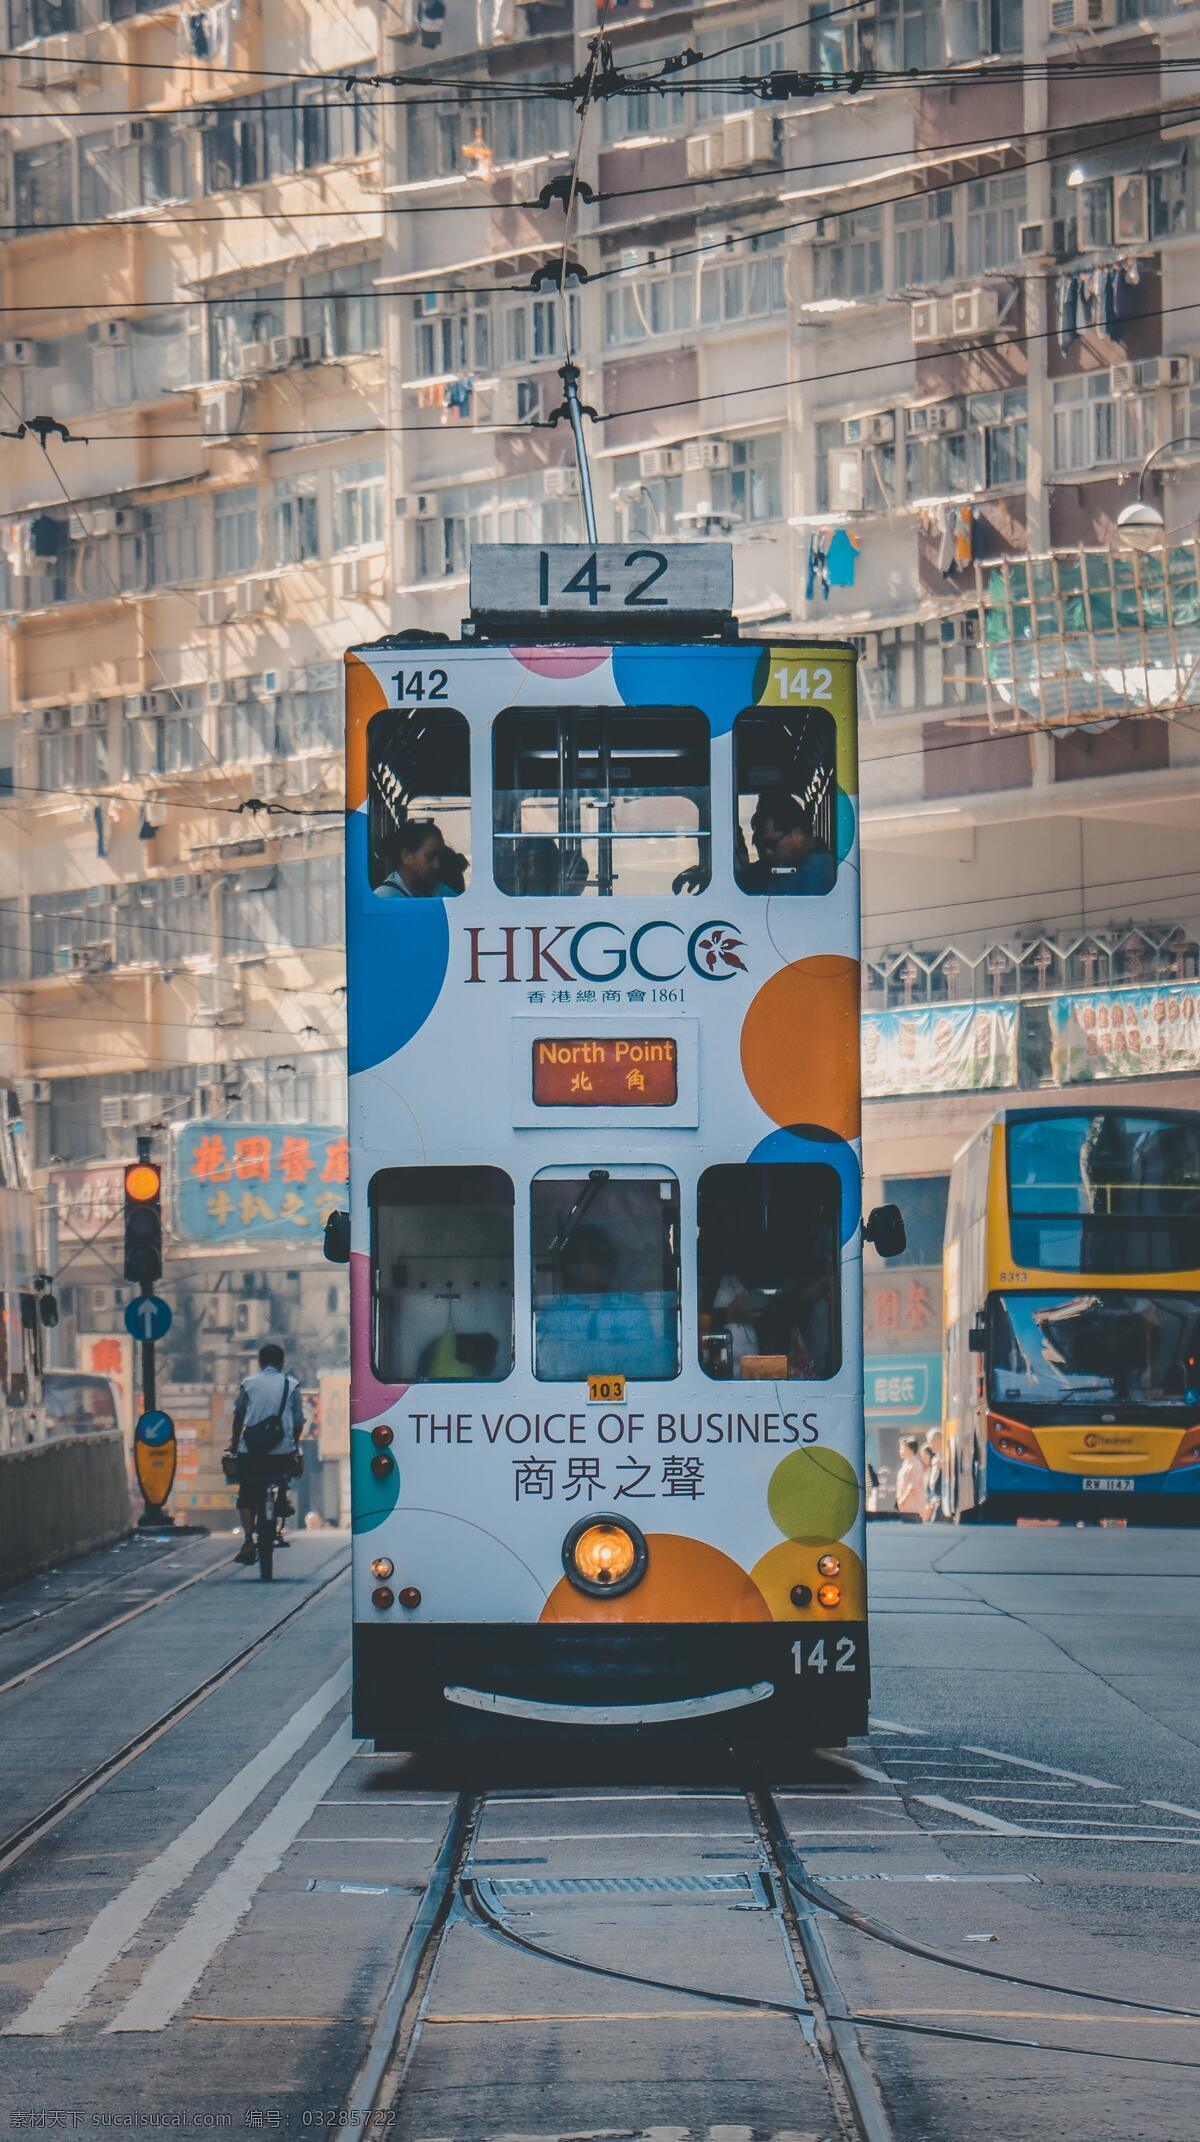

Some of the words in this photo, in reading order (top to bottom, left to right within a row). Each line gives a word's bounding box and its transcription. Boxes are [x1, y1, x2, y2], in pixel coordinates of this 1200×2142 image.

[540, 550, 667, 606] 142
[391, 669, 449, 701] 142
[773, 668, 833, 700] 142
[463, 920, 744, 983] HKGCC
[539, 1042, 605, 1064] North
[615, 1041, 673, 1063] Point
[570, 1068, 645, 1092] 北角
[591, 1382, 622, 1398] 103
[408, 1413, 473, 1443] THE
[481, 1413, 587, 1444] VOICE
[597, 1413, 645, 1443] OF
[657, 1412, 819, 1444] BUSINESS
[511, 1455, 705, 1501] 商界之聲
[1107, 1480, 1131, 1491] 1147
[791, 1636, 857, 1675] 142
